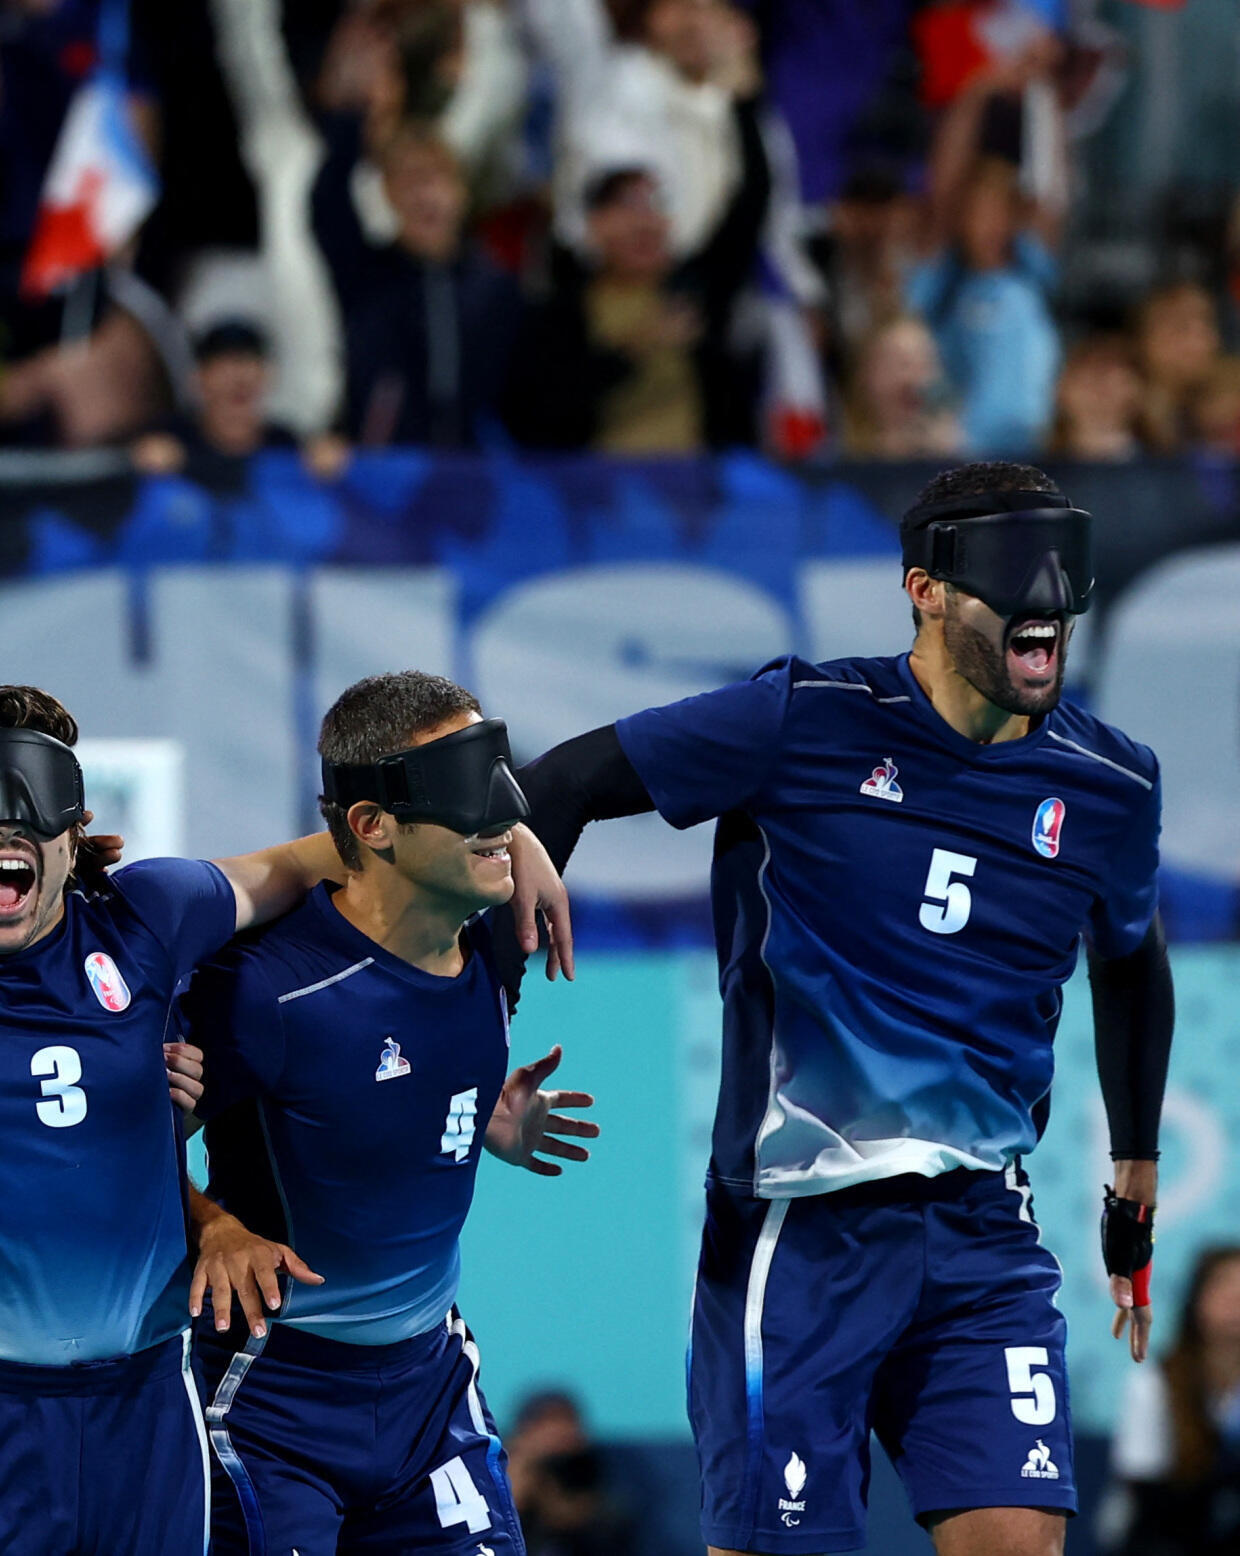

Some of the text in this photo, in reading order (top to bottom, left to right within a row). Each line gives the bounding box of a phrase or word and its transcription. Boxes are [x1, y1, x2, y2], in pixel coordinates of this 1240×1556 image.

[918, 847, 978, 935] 5
[30, 1045, 88, 1128] 3
[440, 1087, 478, 1163] 4
[1004, 1346, 1057, 1425] 5
[429, 1455, 492, 1534] 4
[778, 1498, 806, 1511] FRANCE
